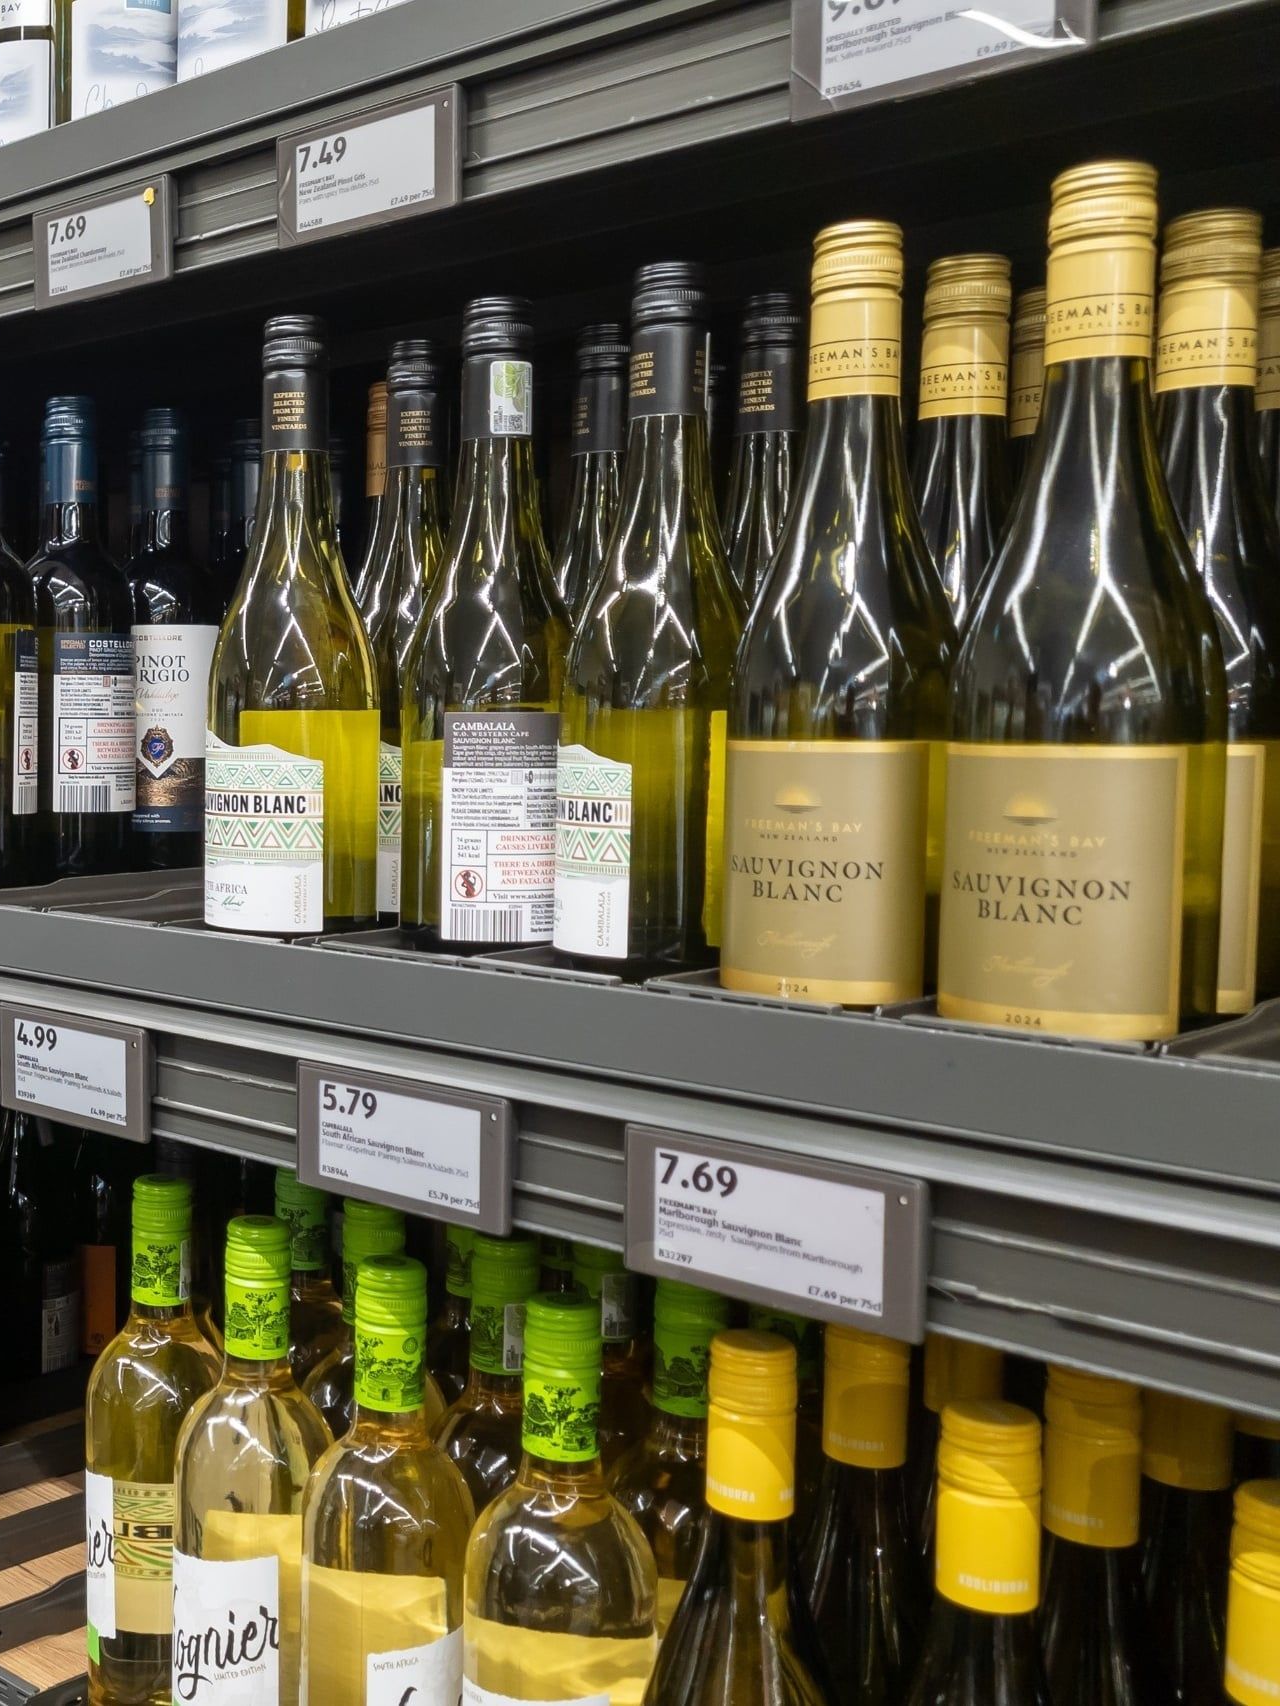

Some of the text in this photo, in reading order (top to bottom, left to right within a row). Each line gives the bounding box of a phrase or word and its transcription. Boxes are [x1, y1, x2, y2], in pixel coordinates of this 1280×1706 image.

[1, 3, 22, 14] BAY
[825, 15, 943, 54] Marlborough Sauvignon
[298, 136, 348, 173] 7.49
[298, 172, 366, 197] New Zealand Pinot Gris
[390, 195, 409, 206] £7.49
[409, 192, 421, 204] per
[49, 215, 87, 246] 7.69
[1047, 302, 1149, 325] EEMAN'S BA
[1158, 336, 1235, 356] REEMAN'S
[809, 346, 899, 366] REEMAN'S BA
[922, 370, 991, 386] REEMAN'S
[273, 391, 306, 400] EXPERTLY
[273, 399, 306, 408] SELECTED
[272, 407, 305, 416] FROM THE
[277, 415, 301, 423] FINEST
[271, 423, 307, 431] VINEYARDS
[136, 668, 190, 685] RIGIO
[452, 721, 516, 731] CAMBALALA
[253, 795, 307, 814] BLANC
[568, 801, 613, 823] BLANC
[745, 818, 865, 834] FREEMAN'S BAY
[495, 843, 526, 851] CAUSES
[500, 834, 541, 842] DRINKING
[783, 834, 839, 843] ZEALAND
[968, 829, 1107, 849] FREEMAN'S BAY
[1014, 848, 1078, 859] ZEALAND
[493, 860, 536, 868] THERE IS A
[501, 869, 539, 877] BETWEEN
[730, 854, 886, 881] SAUVIGNON
[215, 882, 248, 895] AFRICA
[518, 877, 542, 885] FATAL
[952, 869, 1132, 902] SAUVIGNON
[294, 873, 302, 925] CAMBALALA
[751, 879, 844, 904] BLANC
[596, 890, 607, 948] CAMBALALA
[977, 898, 1084, 926] BLANC
[776, 981, 809, 994] 2024
[1005, 1012, 1042, 1027] 2024
[16, 1022, 58, 1052] 4.99
[16, 1059, 89, 1082] South African Sauvignon Blanc
[322, 1083, 378, 1120] 5.79
[90, 1107, 116, 1120] £4.99 per
[321, 1121, 353, 1134] CAMBALALA
[321, 1128, 425, 1158] South African Sauvignon Blanc
[658, 1152, 739, 1199] 7.69
[428, 1189, 449, 1202] £5.79
[450, 1196, 464, 1207] per
[658, 1196, 718, 1217] FREEMAN'S BAY
[658, 1206, 804, 1248] Marlborough Sauvignon Blanc
[730, 1234, 779, 1255] Sauvignon
[779, 1245, 801, 1259] from
[802, 1251, 864, 1275] Marlborough
[807, 1284, 882, 1313] £7.69 per 75cl
[174, 1603, 280, 1701] ognier
[213, 1663, 267, 1681] LIMITED EDITION
[372, 1656, 420, 1673] SOUTH AFRICA
